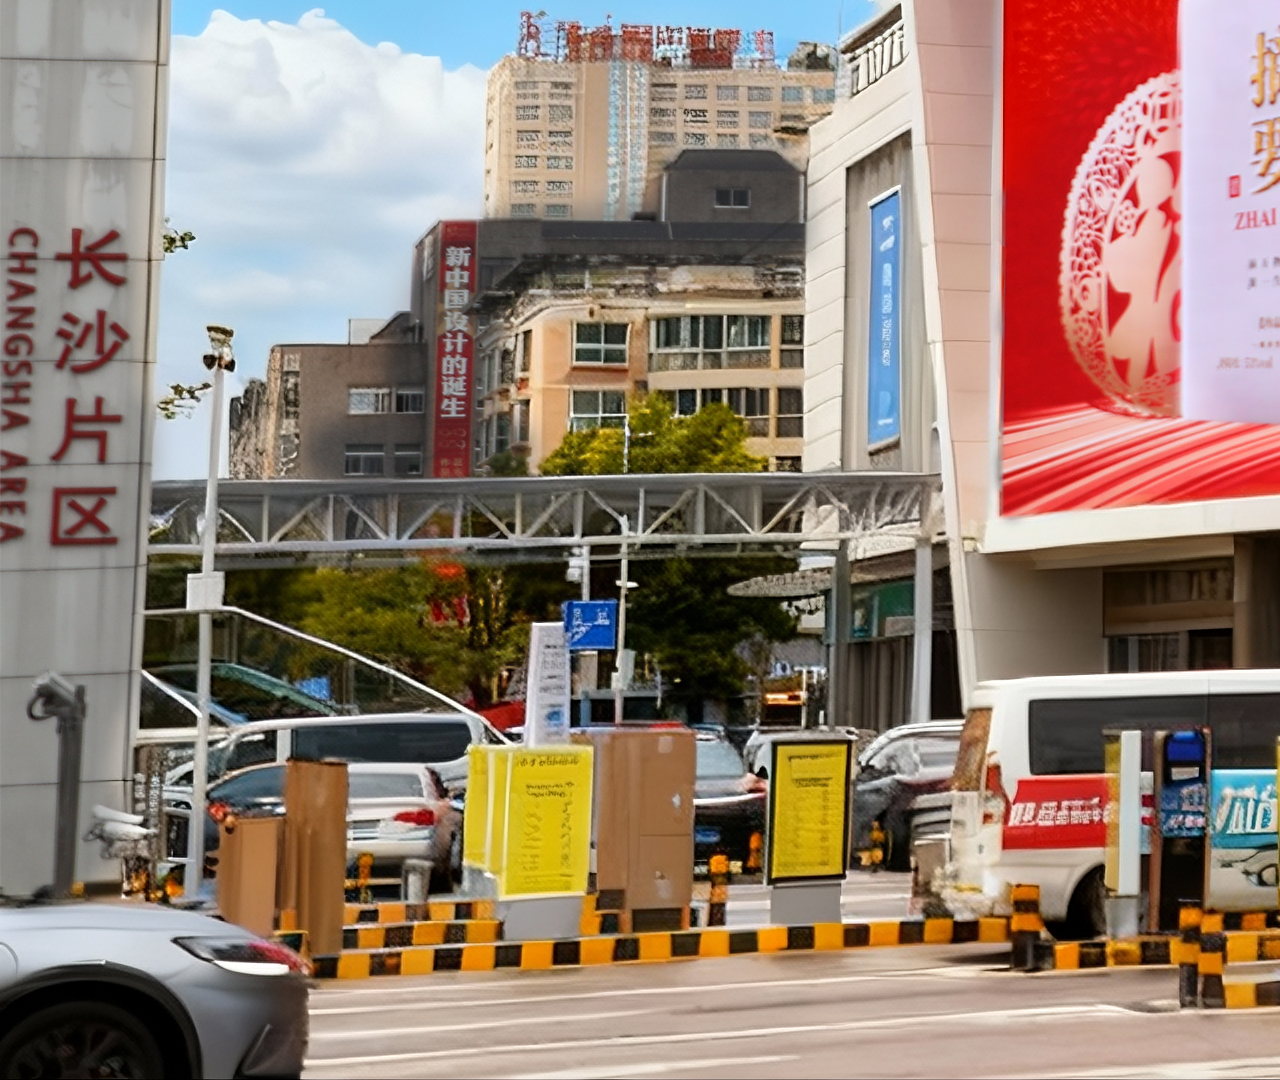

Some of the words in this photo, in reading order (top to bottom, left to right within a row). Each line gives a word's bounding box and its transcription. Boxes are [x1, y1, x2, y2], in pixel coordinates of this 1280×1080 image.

[1234, 207, 1277, 231] ZHAI
[0, 226, 40, 432] CHANGSHA
[50, 227, 130, 547] 长沙片区
[440, 245, 472, 418] 新中国设计的诞生
[0, 448, 30, 545] AREA
